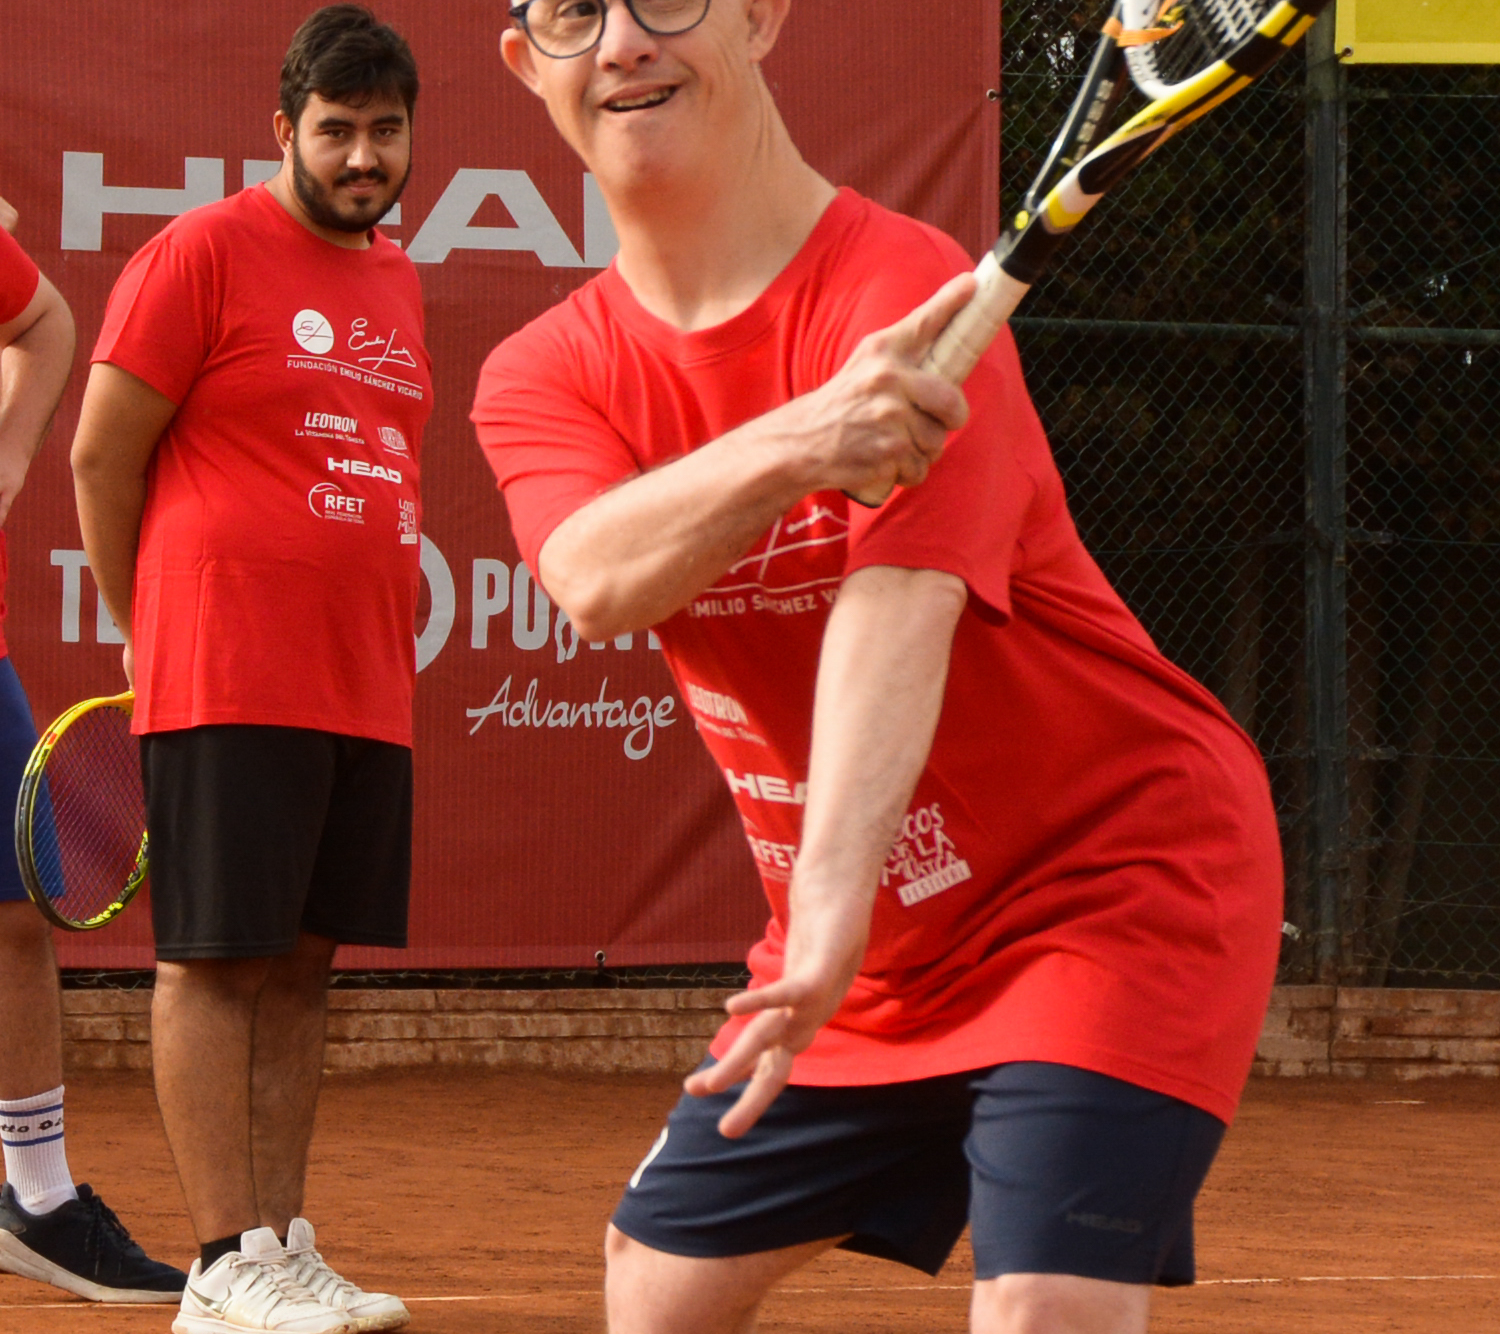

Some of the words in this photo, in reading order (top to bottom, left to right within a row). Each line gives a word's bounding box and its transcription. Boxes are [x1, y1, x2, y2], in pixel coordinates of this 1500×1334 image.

[287, 359, 338, 375] FUNDACIÓN
[364, 374, 396, 392] SÁNCHEZ
[304, 411, 358, 434] LEOTRON
[327, 456, 403, 485] HEAD
[324, 494, 366, 514] RFET
[466, 675, 678, 760] Advantage
